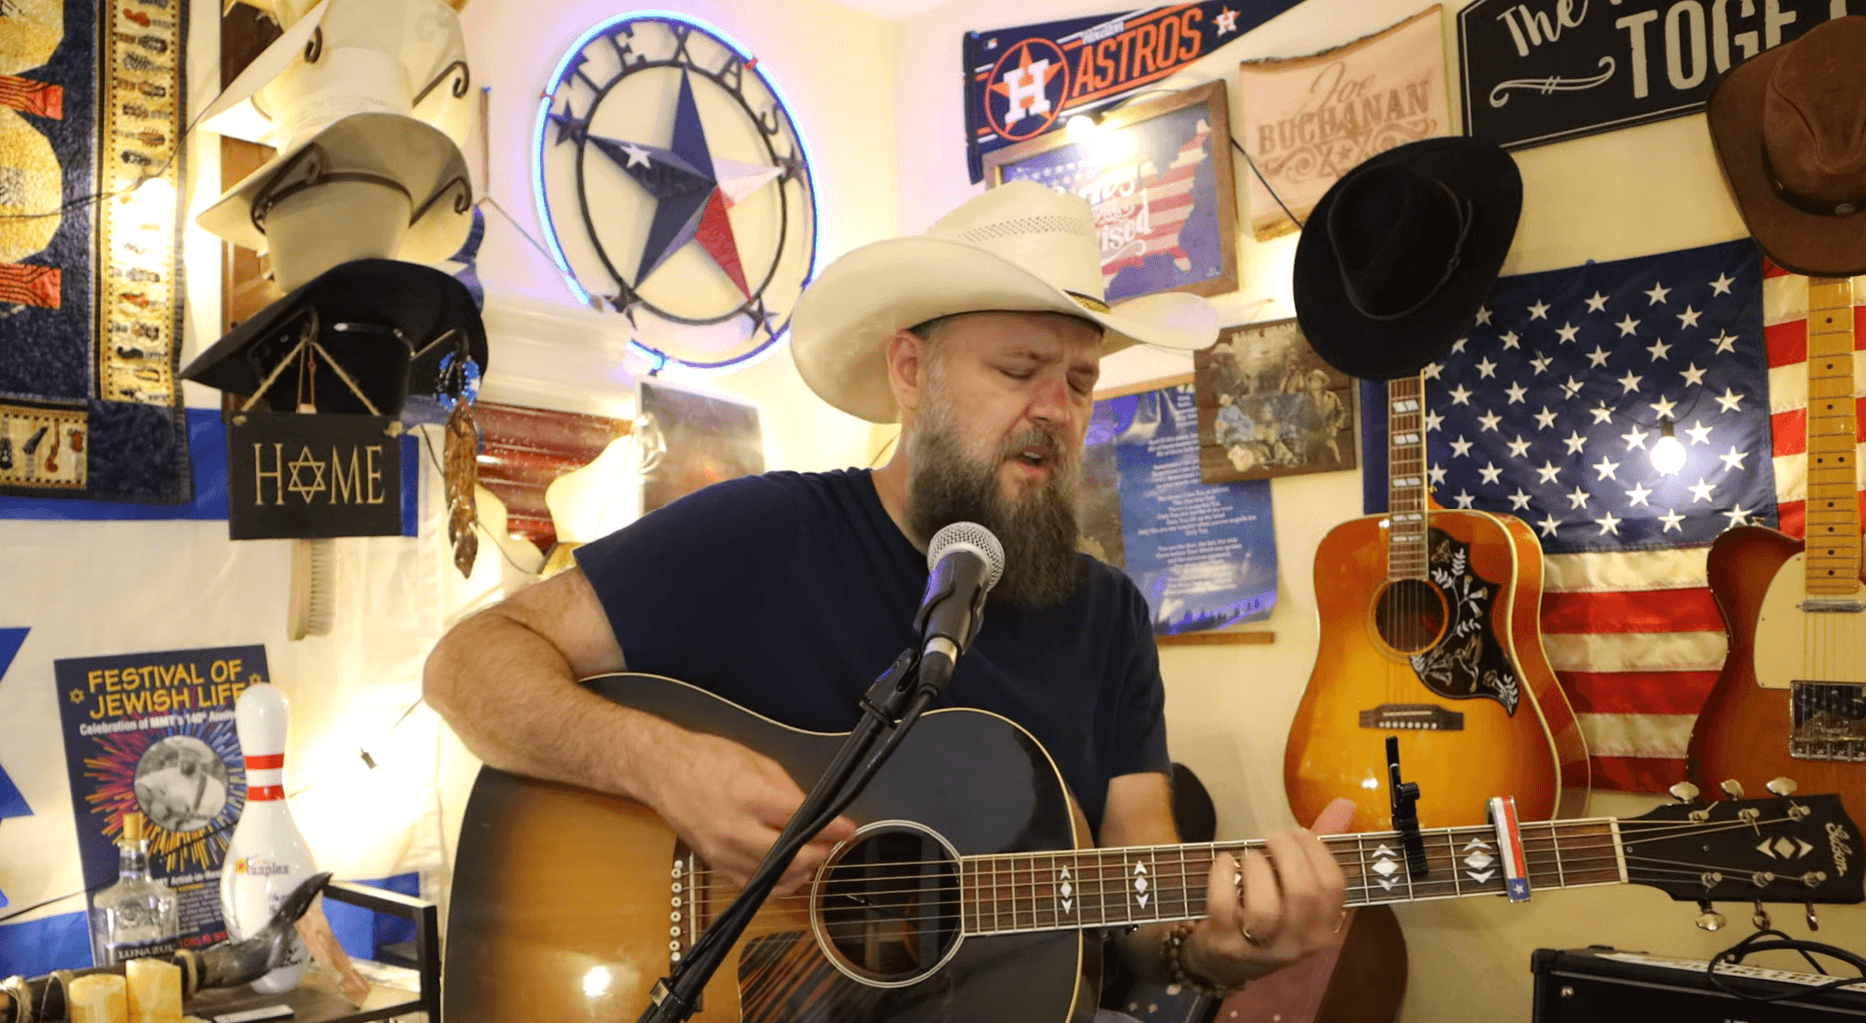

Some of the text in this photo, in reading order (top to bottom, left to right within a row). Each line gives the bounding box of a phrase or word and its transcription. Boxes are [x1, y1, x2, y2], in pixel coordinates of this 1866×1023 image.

[1071, 7, 1203, 98] ASTROS
[1497, 0, 1590, 57] The
[558, 24, 782, 136] TEXAS
[1003, 58, 1051, 123] H
[1297, 61, 1376, 114] Joe
[1257, 69, 1433, 156] BUCHANAN
[87, 659, 243, 694] FESTIVAL OF
[89, 682, 247, 720] JEWISH LIFE
[79, 720, 138, 736] Celebration
[138, 716, 149, 730] of
[1825, 822, 1853, 877] Gibson
[118, 944, 174, 960] LUNAZUL
